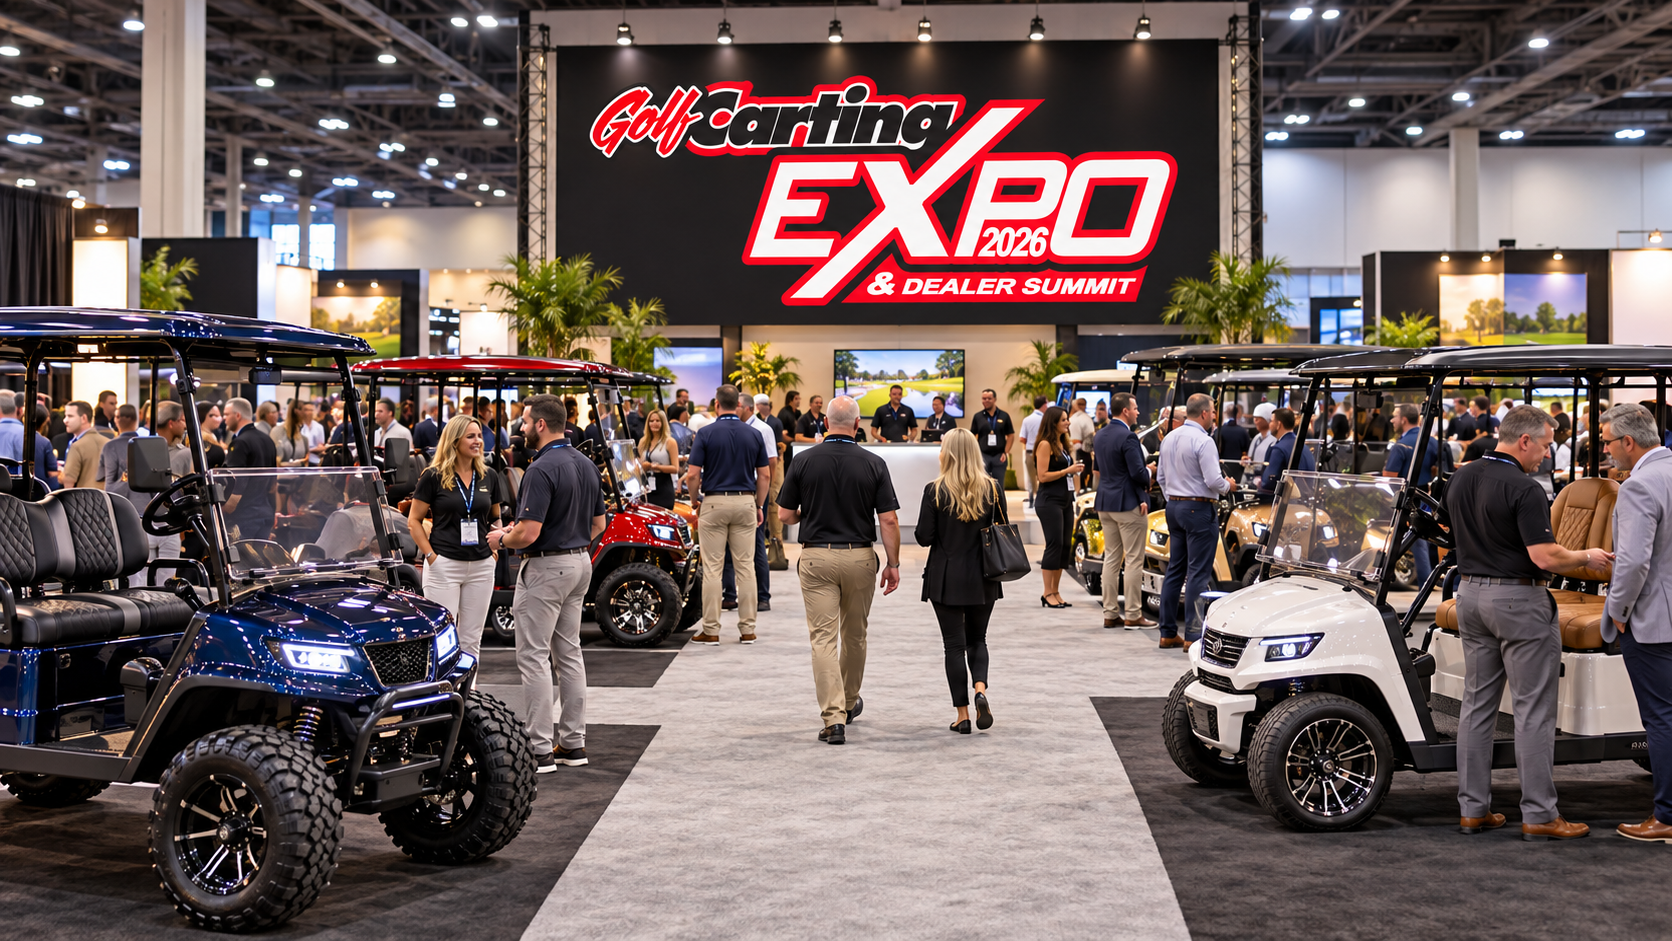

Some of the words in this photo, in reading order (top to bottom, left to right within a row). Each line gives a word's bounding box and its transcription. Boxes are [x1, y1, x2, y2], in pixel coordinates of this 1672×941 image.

[746, 103, 1175, 302] EXPO
[978, 226, 1049, 258] 2026
[866, 271, 896, 296] &
[902, 278, 1017, 296] DEALER
[1022, 277, 1137, 296] SUMMIT
